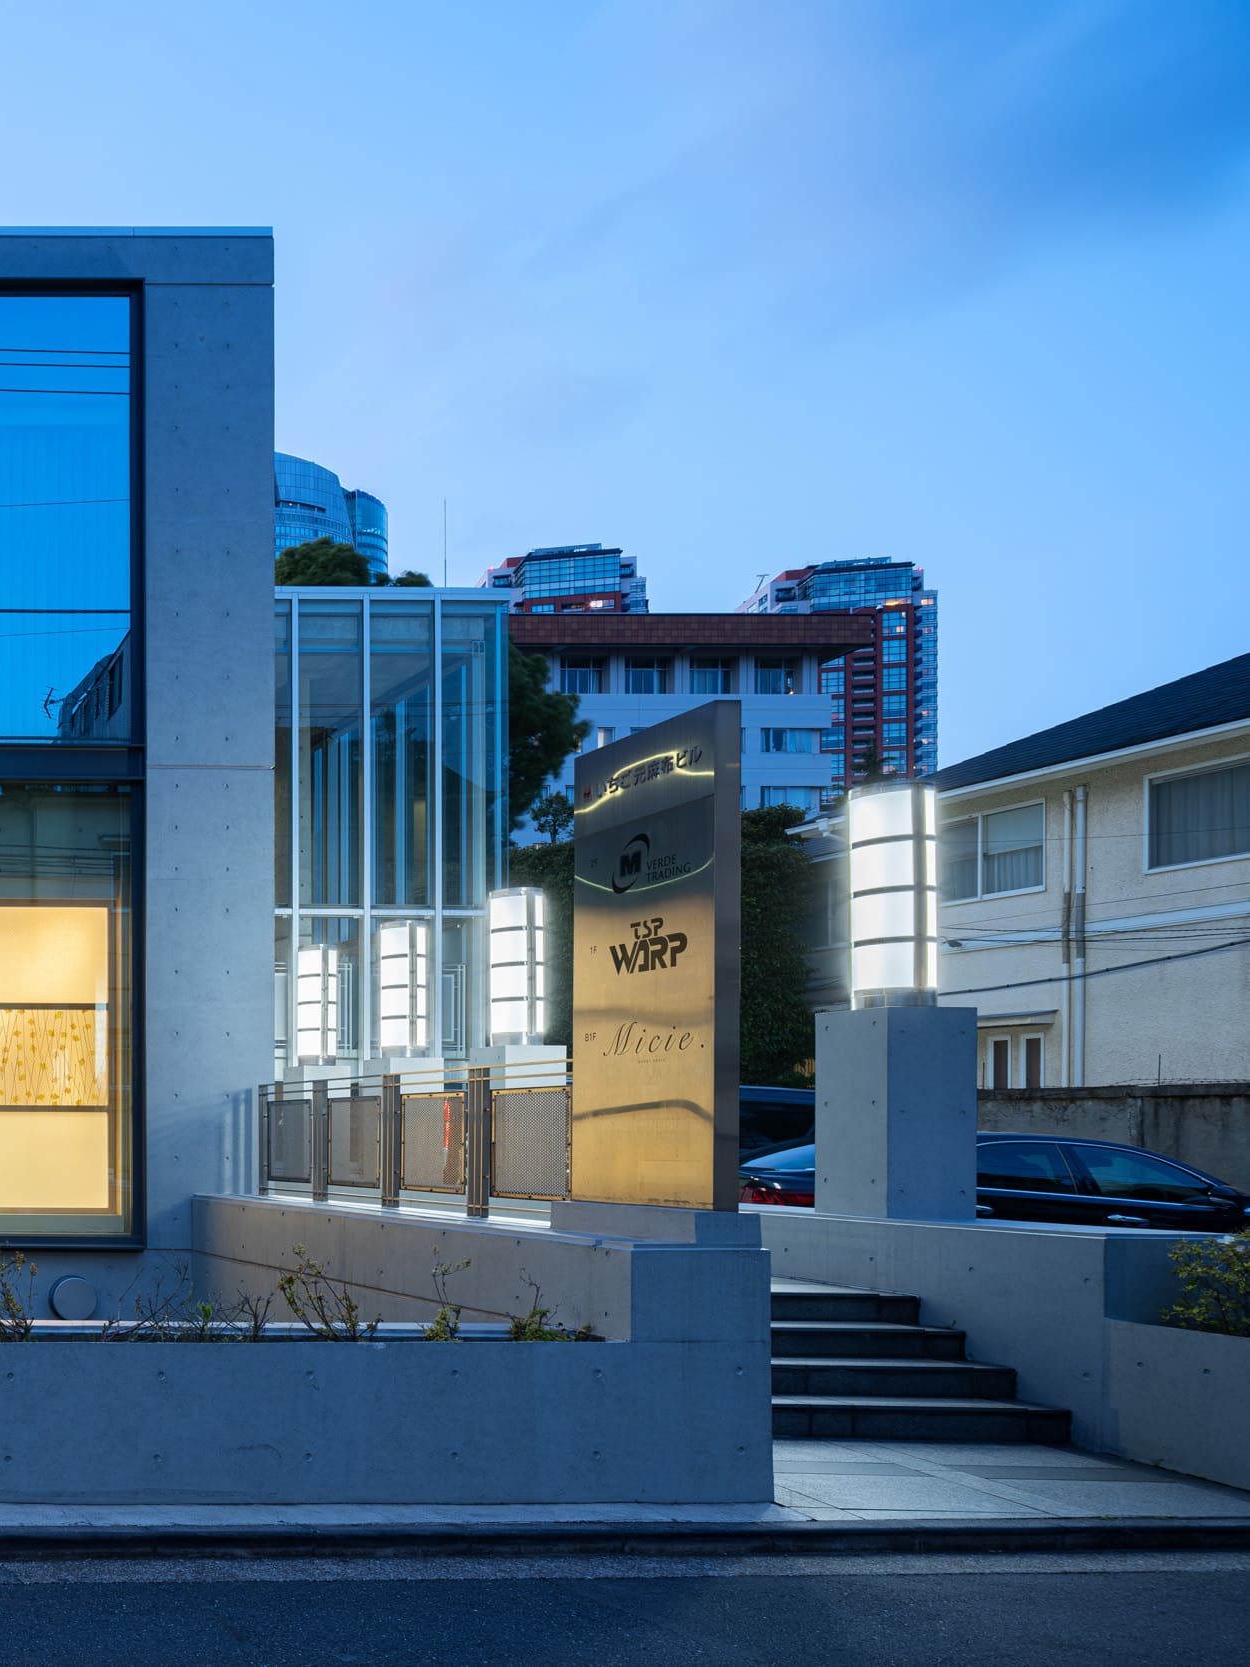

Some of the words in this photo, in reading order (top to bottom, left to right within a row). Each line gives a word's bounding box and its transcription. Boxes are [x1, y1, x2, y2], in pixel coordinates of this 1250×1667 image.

[646, 854, 677, 870] VERDE
[646, 863, 692, 882] TRADING
[630, 917, 664, 939] TSP
[589, 946, 598, 955] 1F
[609, 932, 688, 976] WARP
[584, 1032, 597, 1042] B1F
